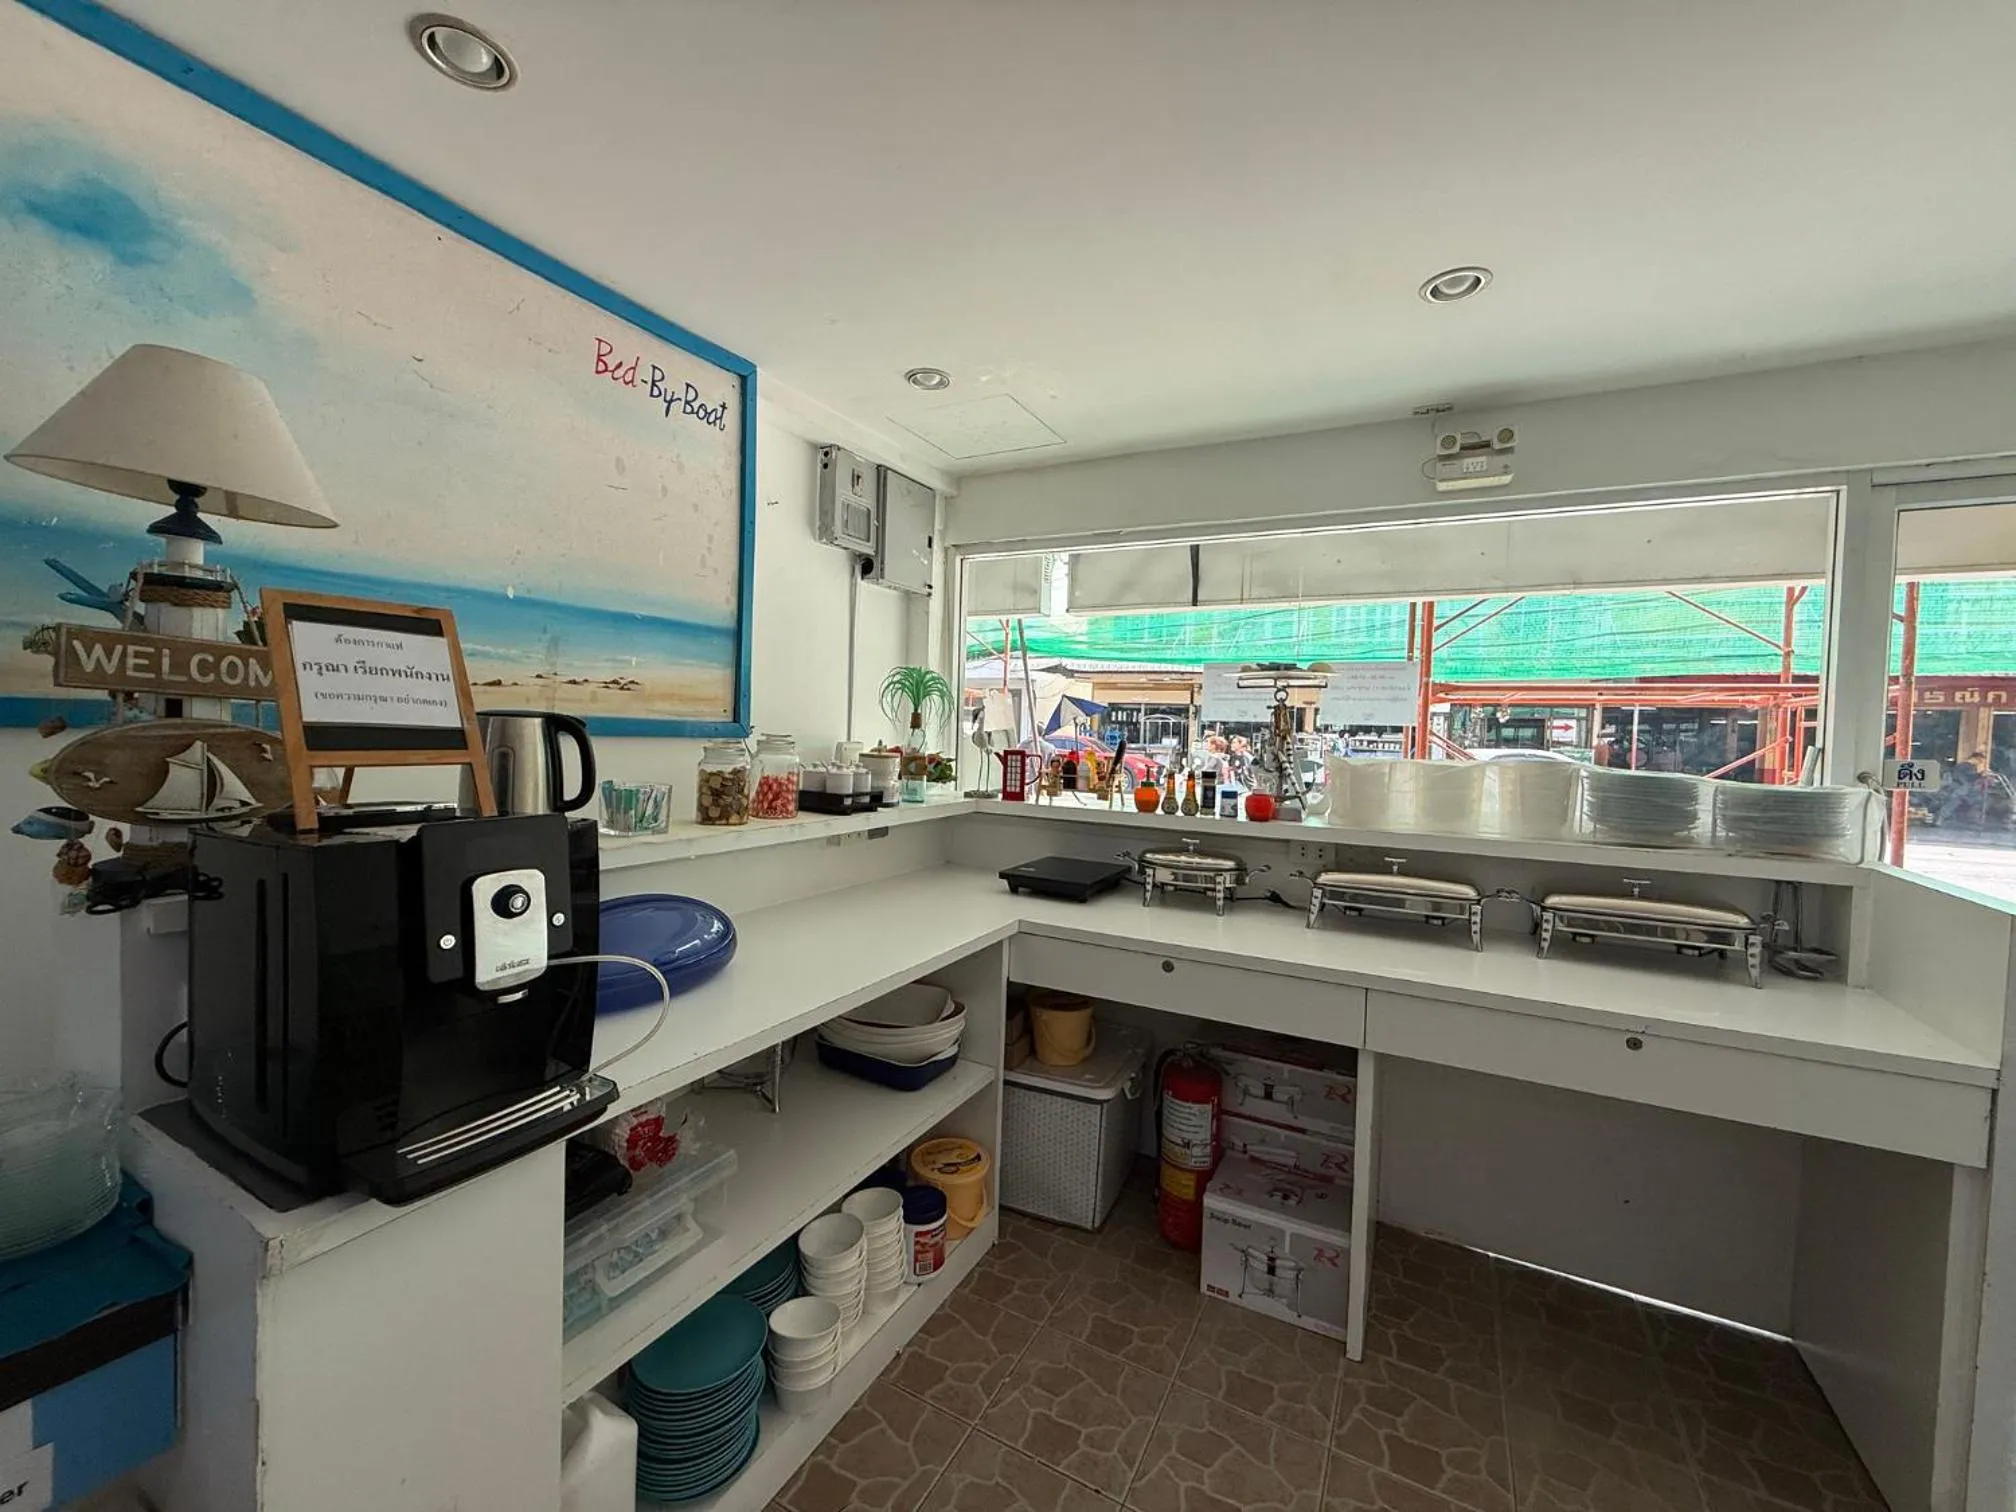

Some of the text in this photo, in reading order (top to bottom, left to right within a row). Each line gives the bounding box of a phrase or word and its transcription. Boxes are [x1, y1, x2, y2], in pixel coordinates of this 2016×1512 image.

[301, 660, 451, 683] กรุณา เรียกพนักงาน
